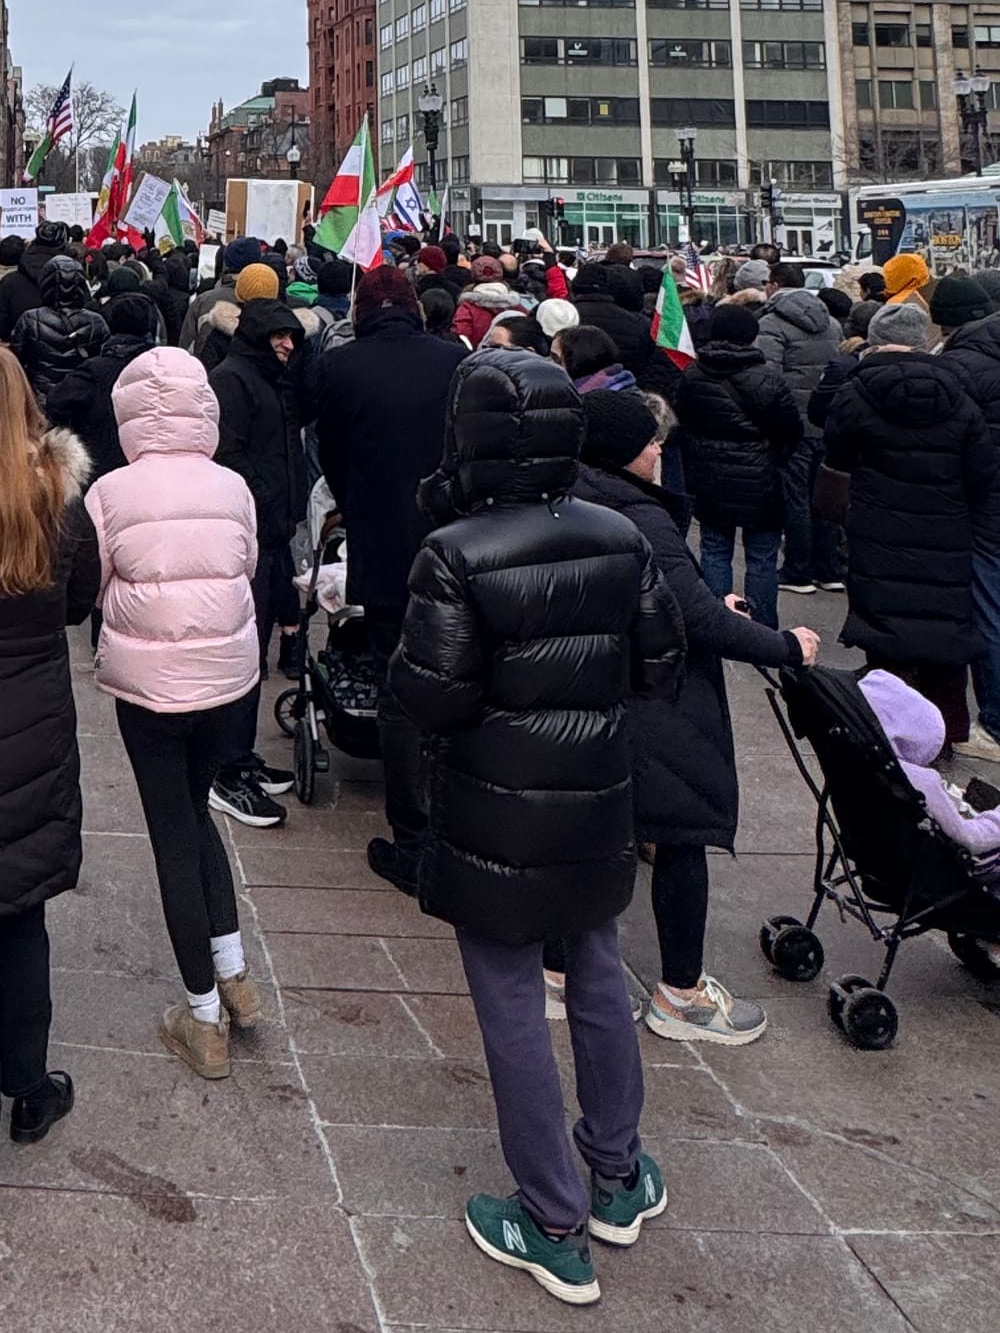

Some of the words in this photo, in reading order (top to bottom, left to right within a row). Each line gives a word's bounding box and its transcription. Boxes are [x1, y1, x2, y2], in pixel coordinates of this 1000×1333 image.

[10, 196, 26, 206] NO
[586, 192, 623, 202] Citizens
[6, 214, 32, 224] WITH
